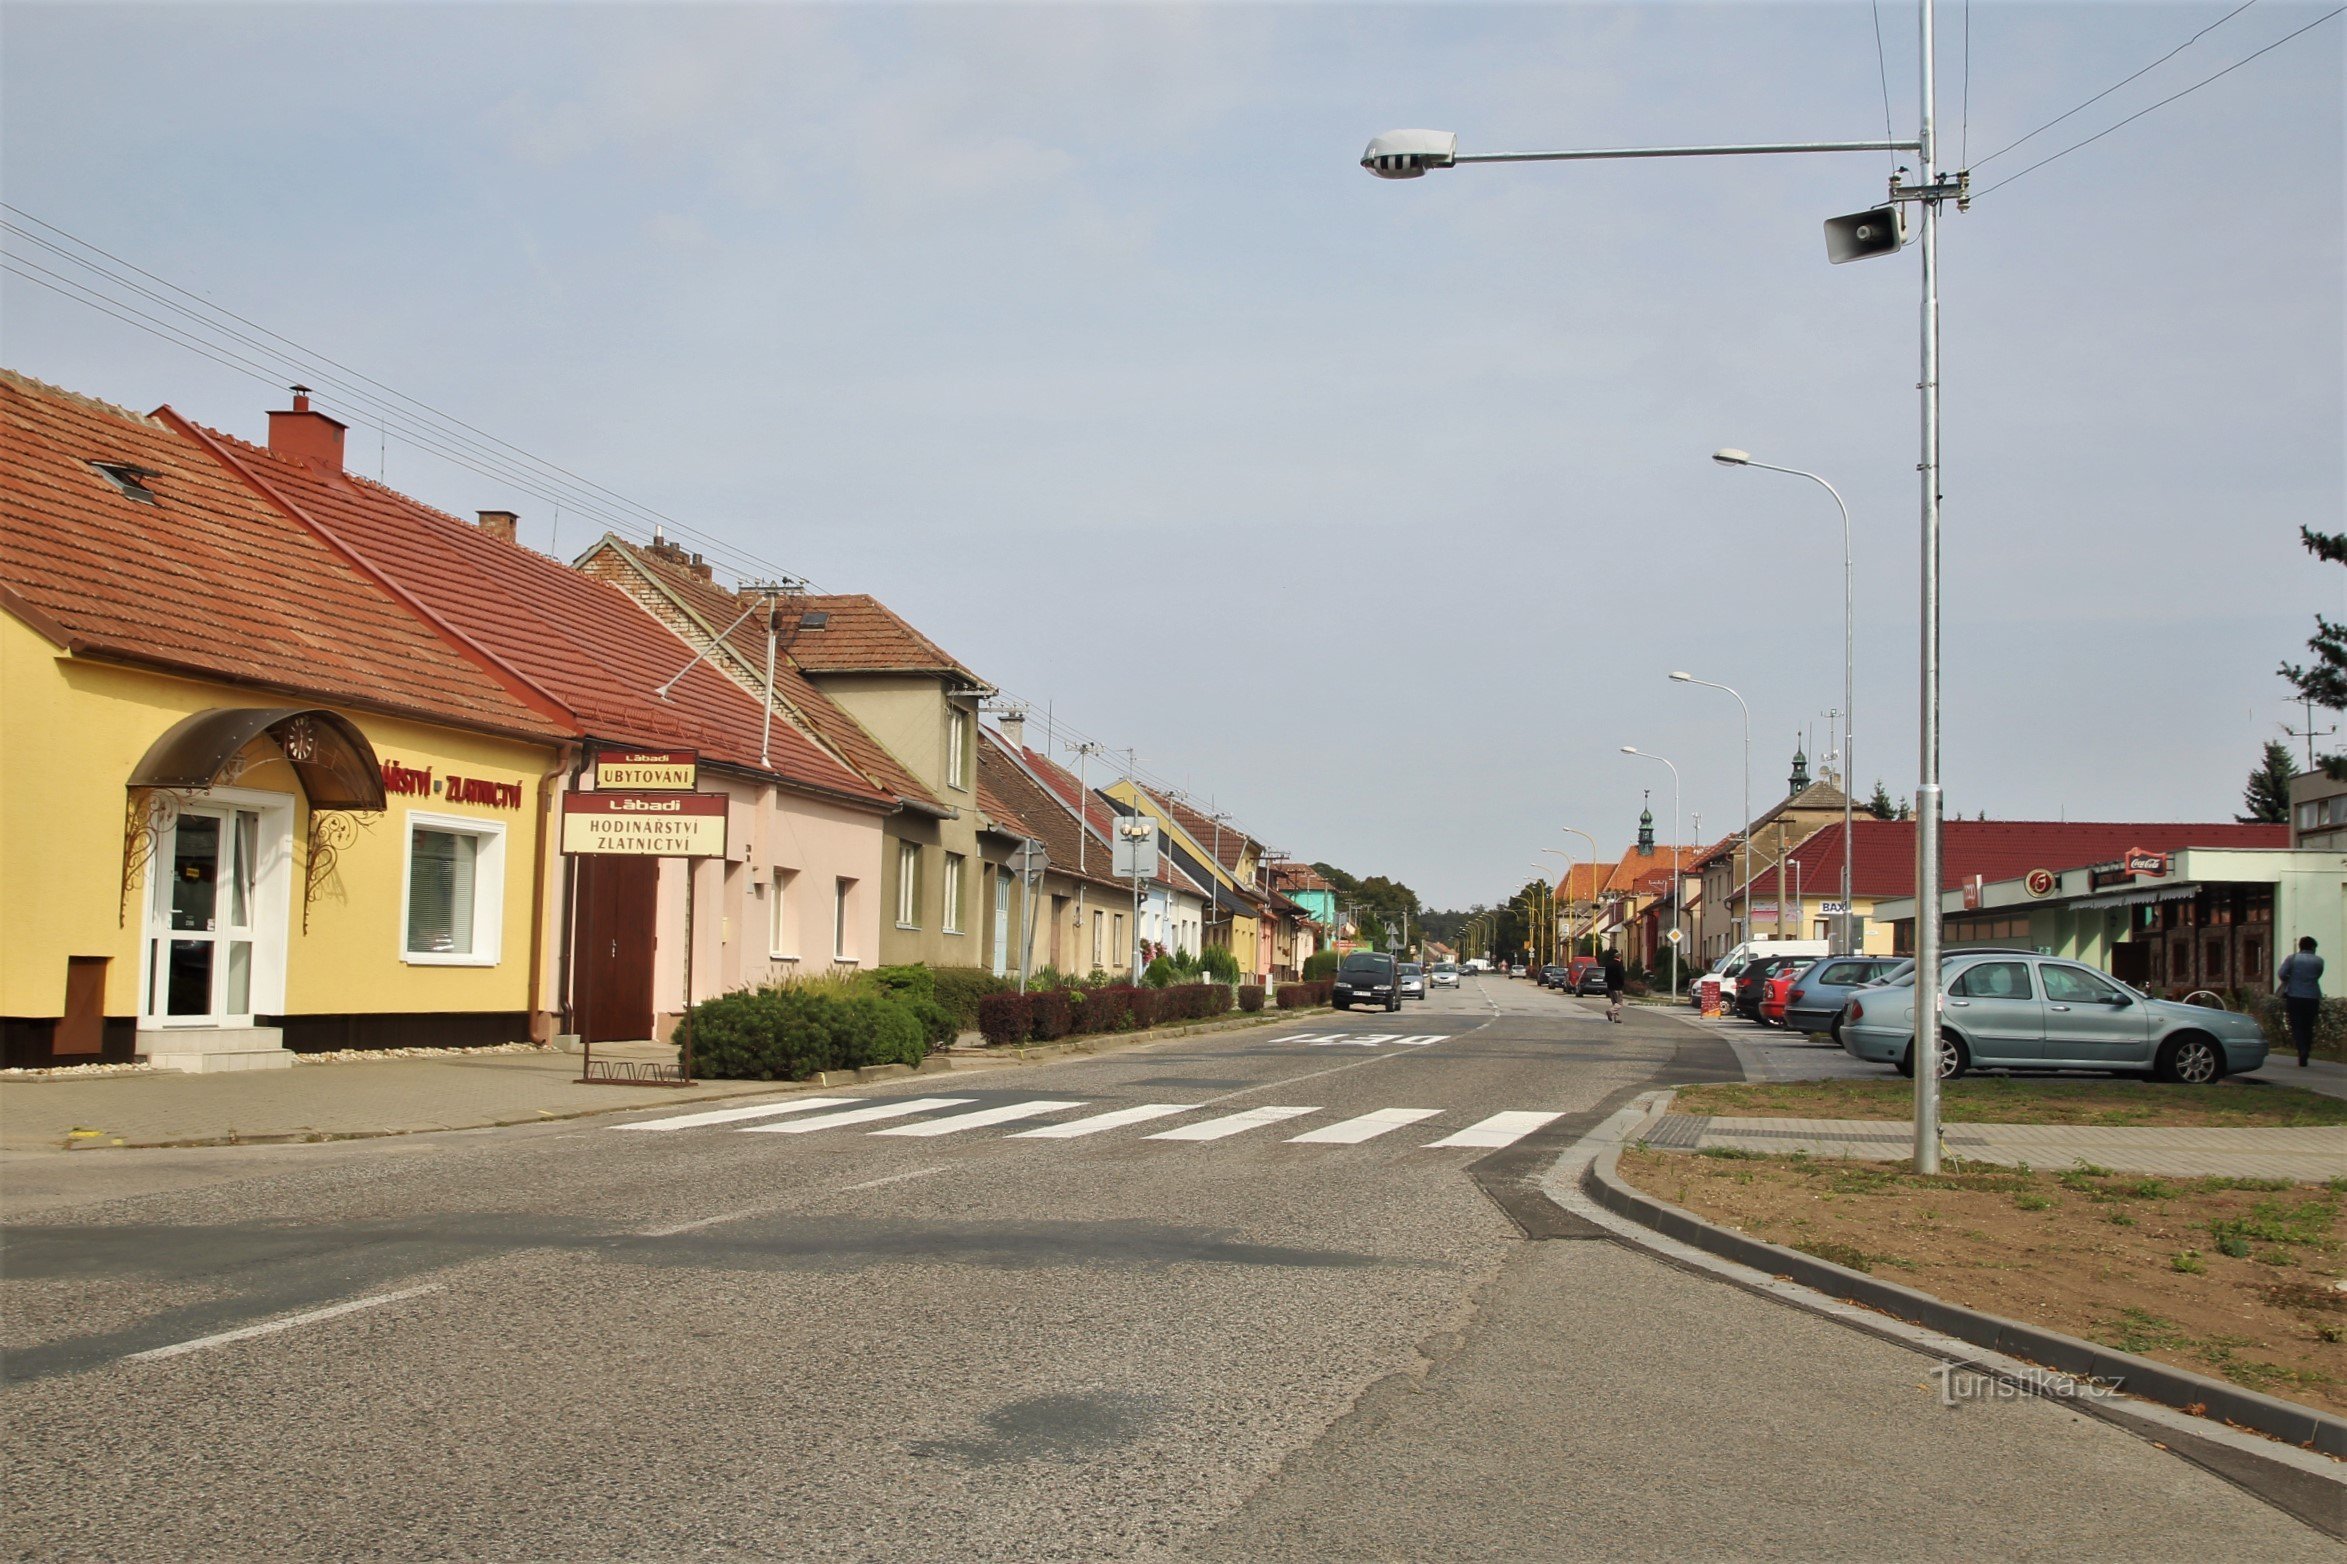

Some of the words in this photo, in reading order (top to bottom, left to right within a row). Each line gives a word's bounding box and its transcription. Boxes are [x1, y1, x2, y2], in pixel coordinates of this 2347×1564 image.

[604, 767, 689, 783] UBYTOVÁNÍ
[378, 759, 431, 797] ÁŘSTVÍ
[445, 775, 523, 810] ZLATNICTVÍ
[590, 818, 698, 835] HODINÁŘSTVÍ
[597, 835, 690, 851] ZLATNICTVÍ
